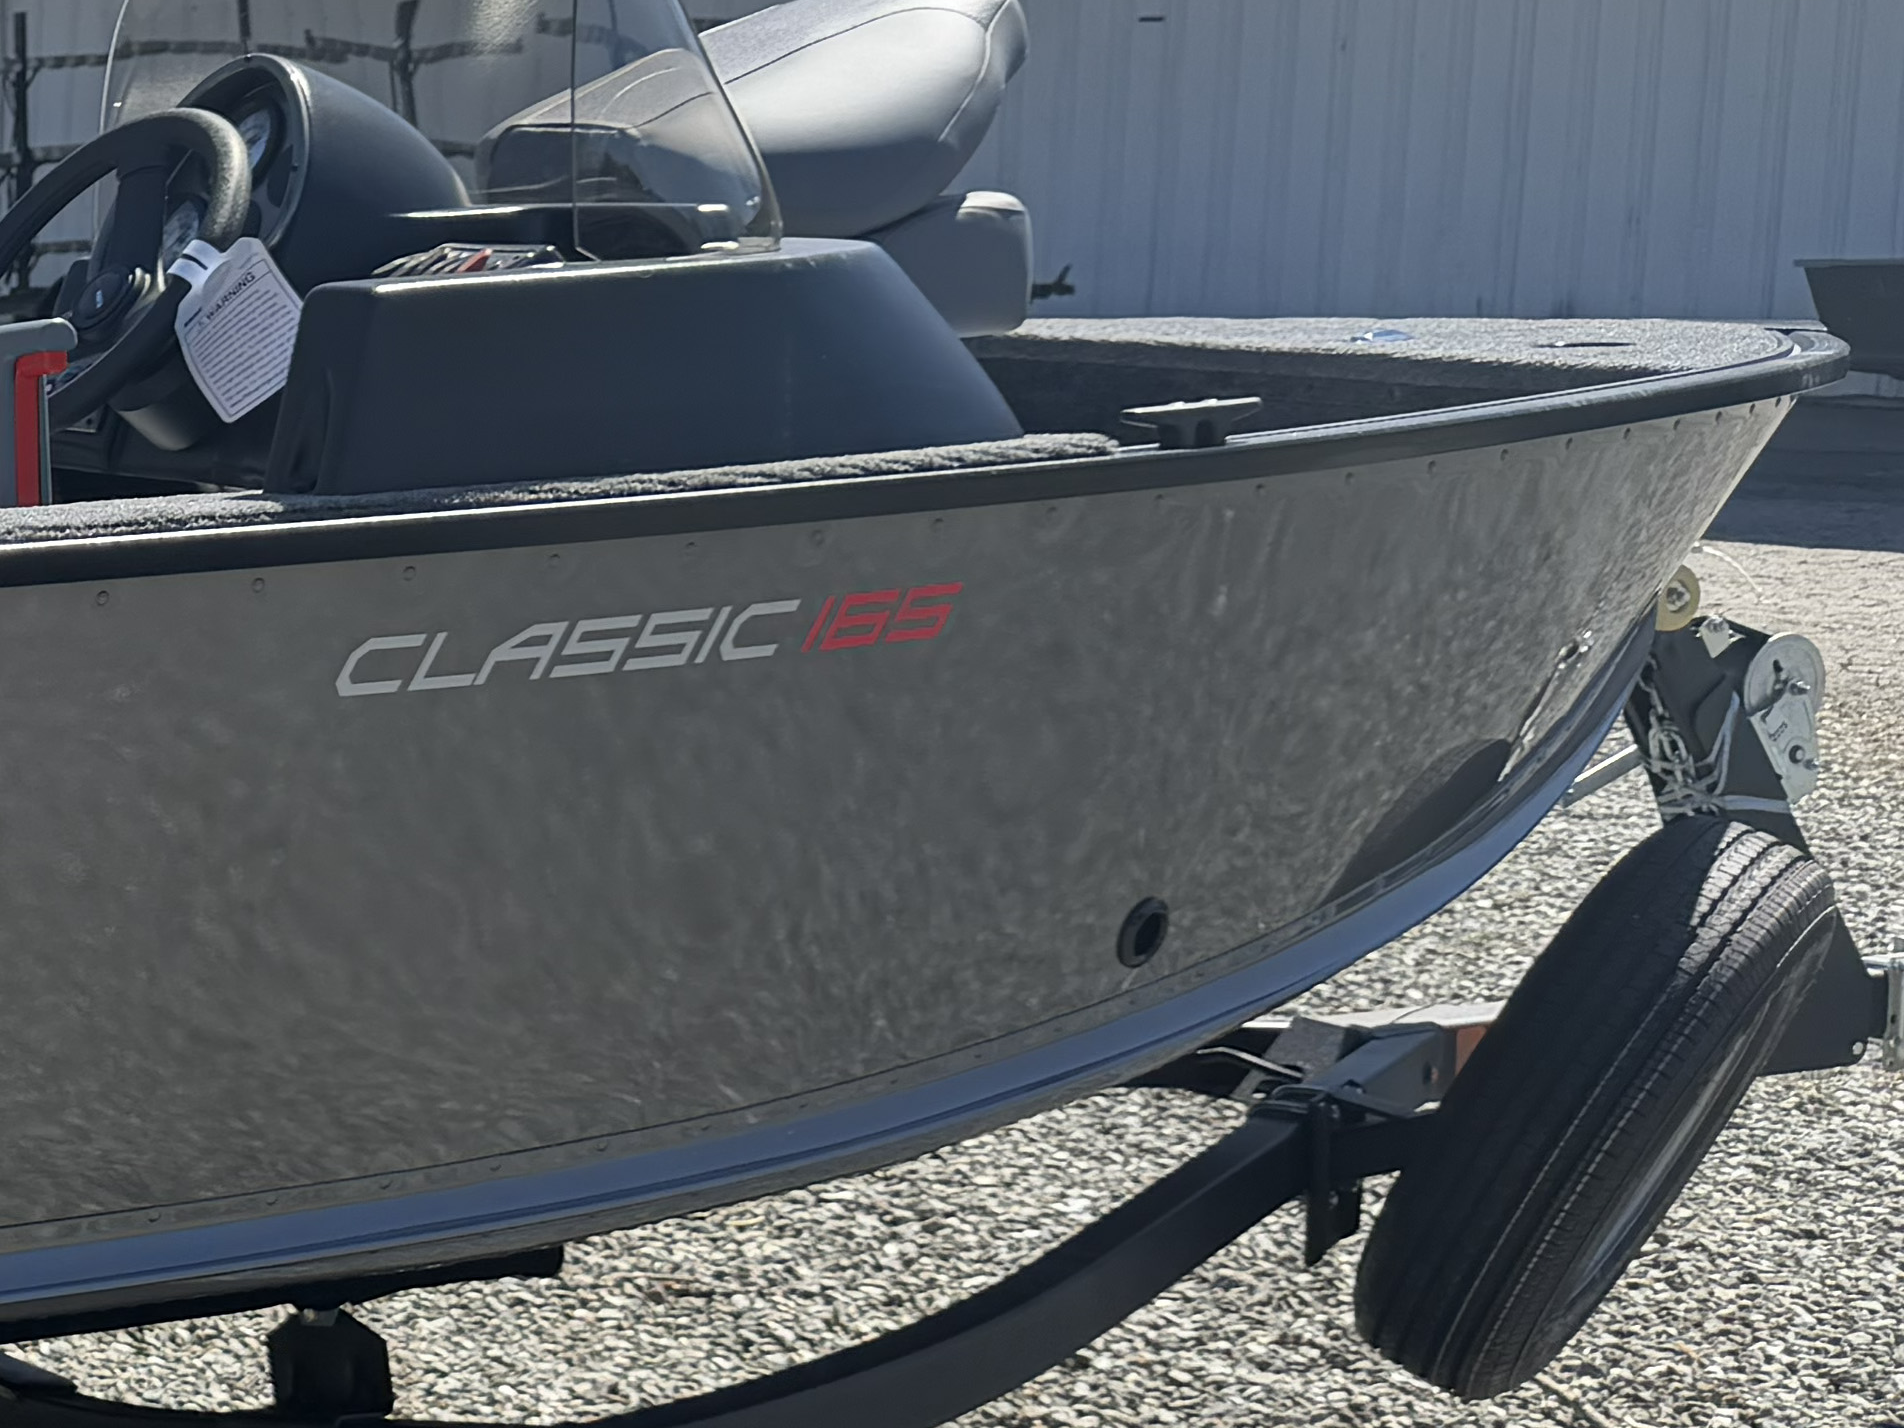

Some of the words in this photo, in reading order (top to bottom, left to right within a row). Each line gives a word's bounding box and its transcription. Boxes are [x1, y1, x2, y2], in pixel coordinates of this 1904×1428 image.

[206, 272, 256, 320] WARNING
[335, 598, 801, 697] CLASSIC
[800, 581, 963, 653] 165
